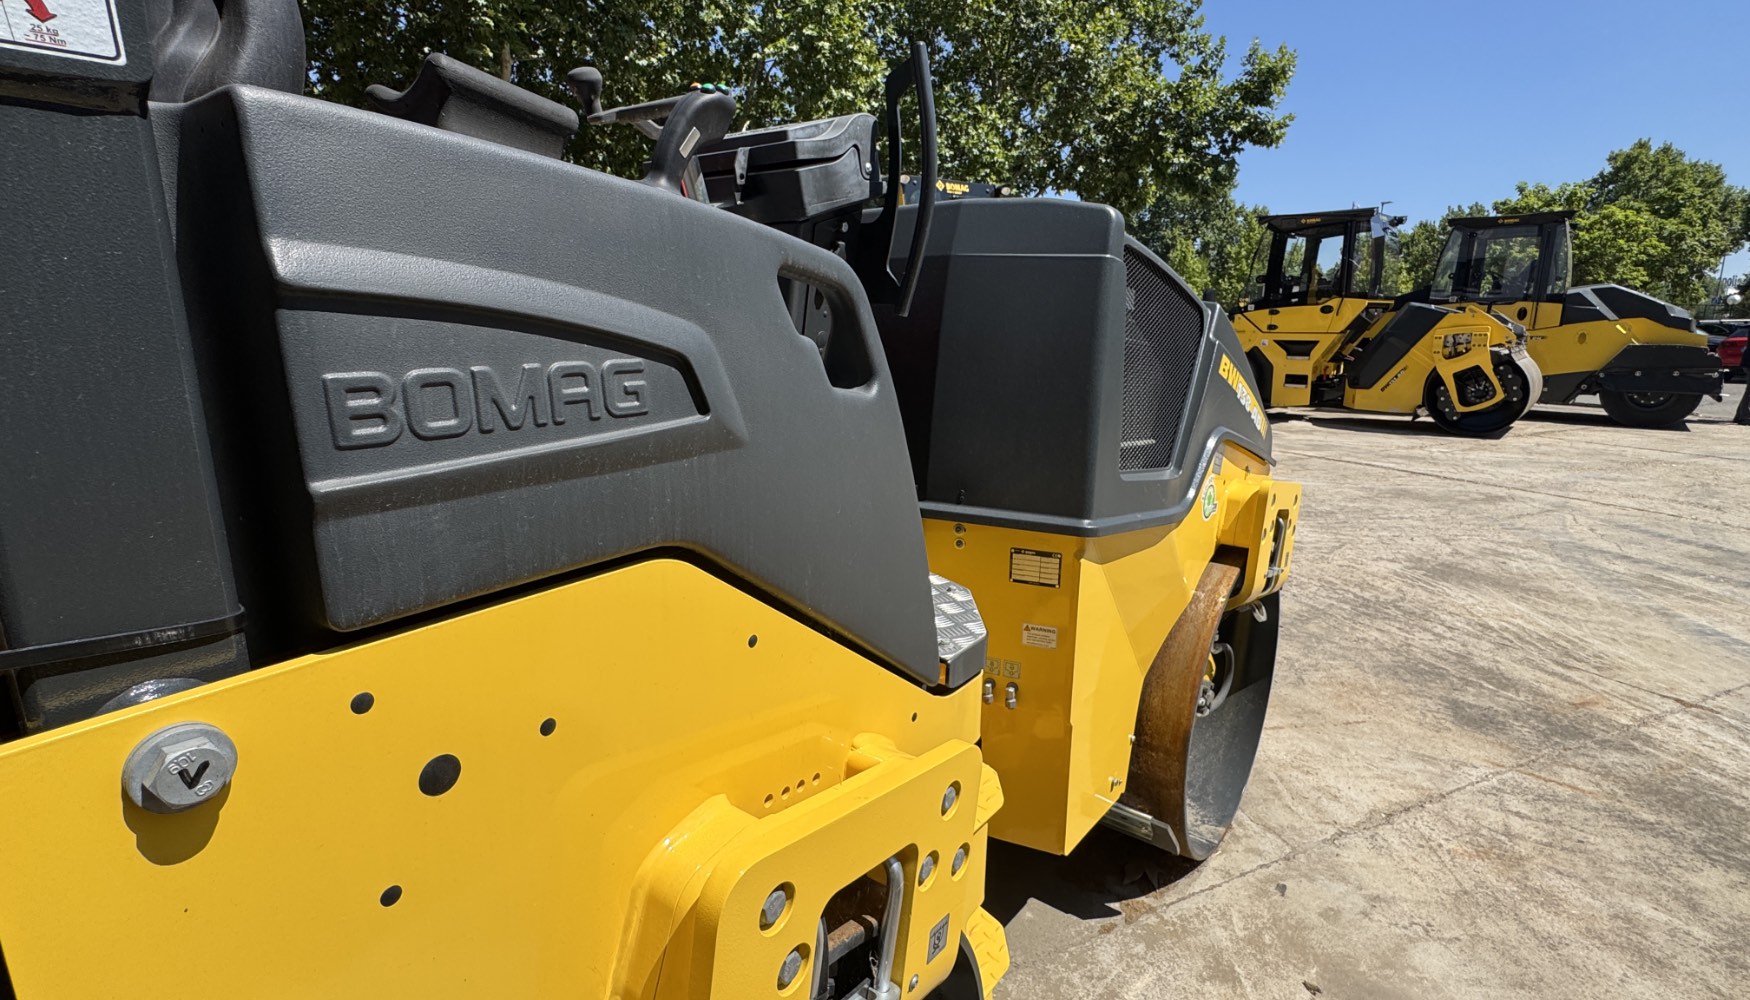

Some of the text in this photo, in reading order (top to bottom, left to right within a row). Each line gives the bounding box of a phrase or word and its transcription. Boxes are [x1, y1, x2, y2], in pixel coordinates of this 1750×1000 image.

[29, 23, 59, 36] 25 kg
[33, 33, 46, 41] 75
[48, 35, 66, 46] Nm
[322, 358, 648, 450] BOMAG
[1030, 626, 1056, 634] WARNING
